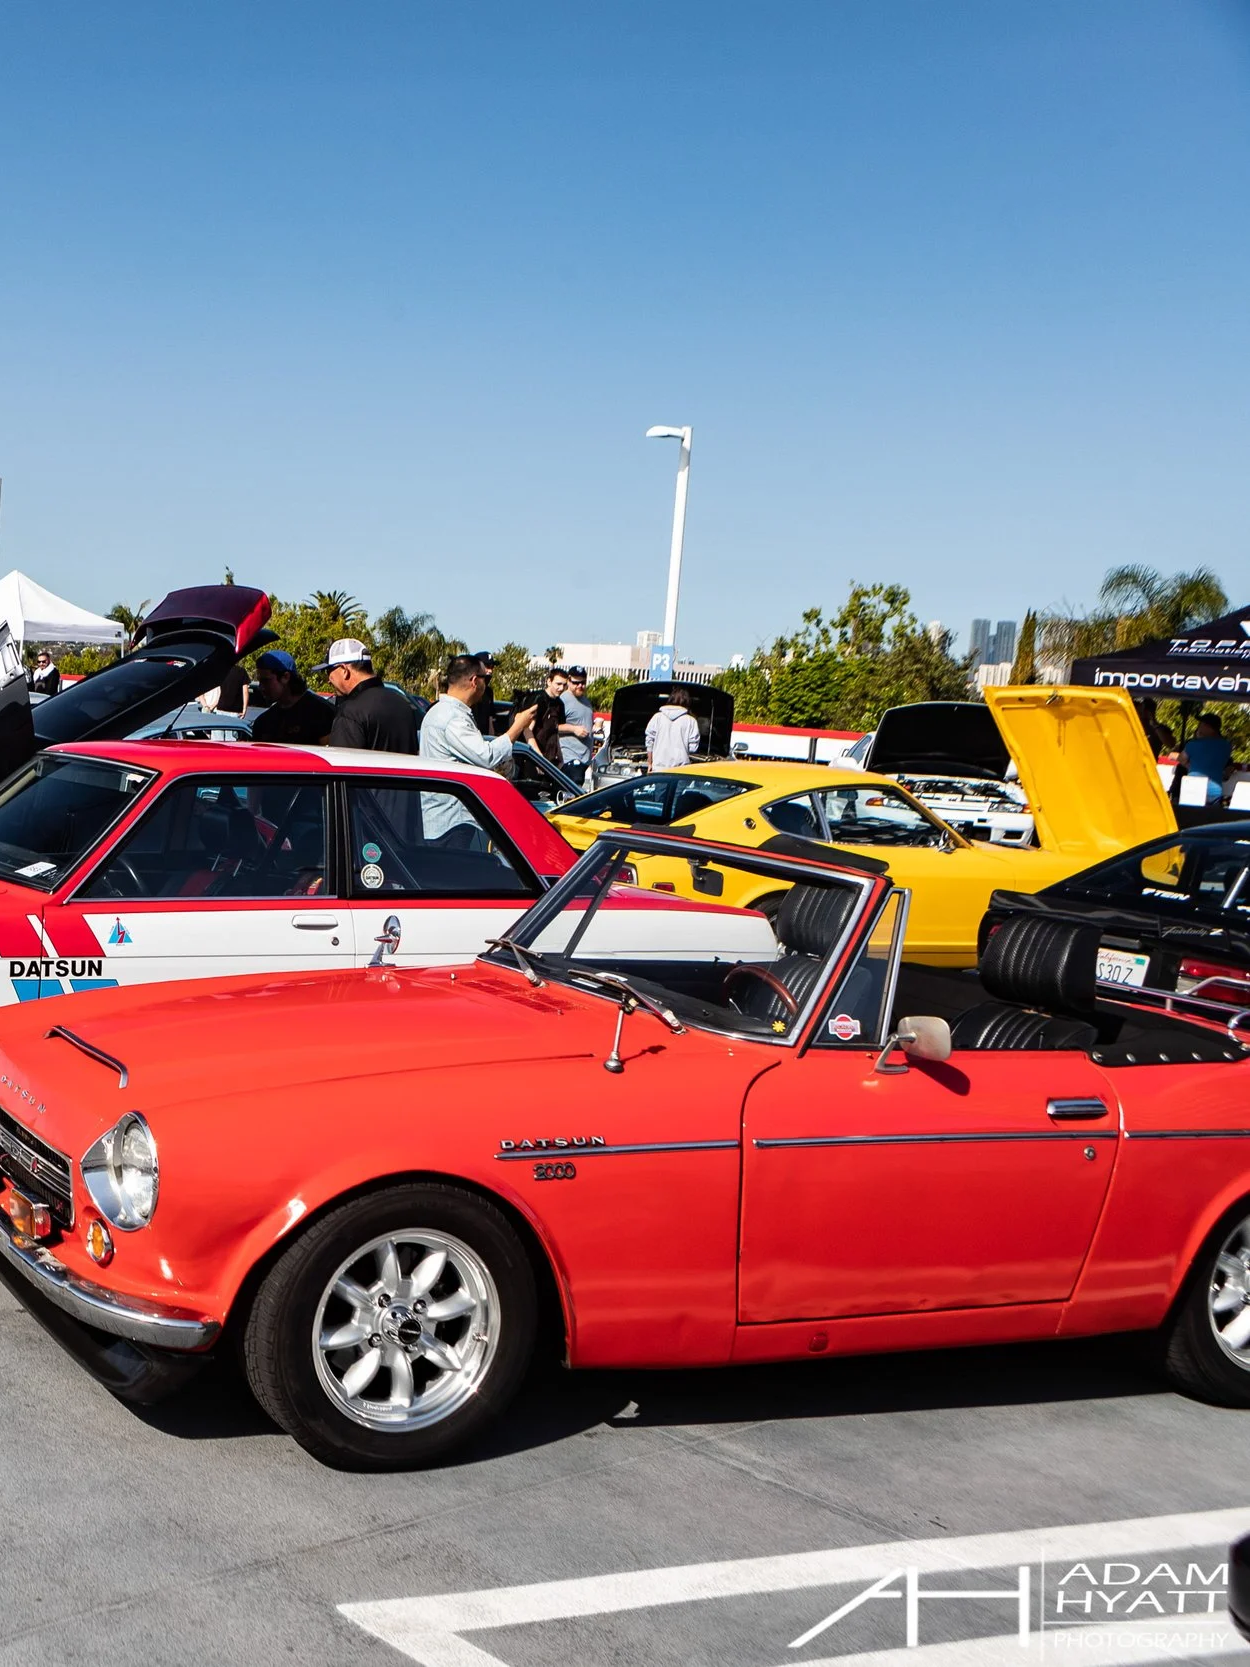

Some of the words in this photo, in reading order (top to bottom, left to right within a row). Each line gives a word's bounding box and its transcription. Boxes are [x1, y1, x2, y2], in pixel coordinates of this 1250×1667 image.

[653, 653, 670, 671] P3
[10, 960, 102, 977] DATSUN
[0, 1075, 47, 1114] DATSUN
[500, 1136, 606, 1150] DATSUN
[533, 1163, 576, 1180] 2000
